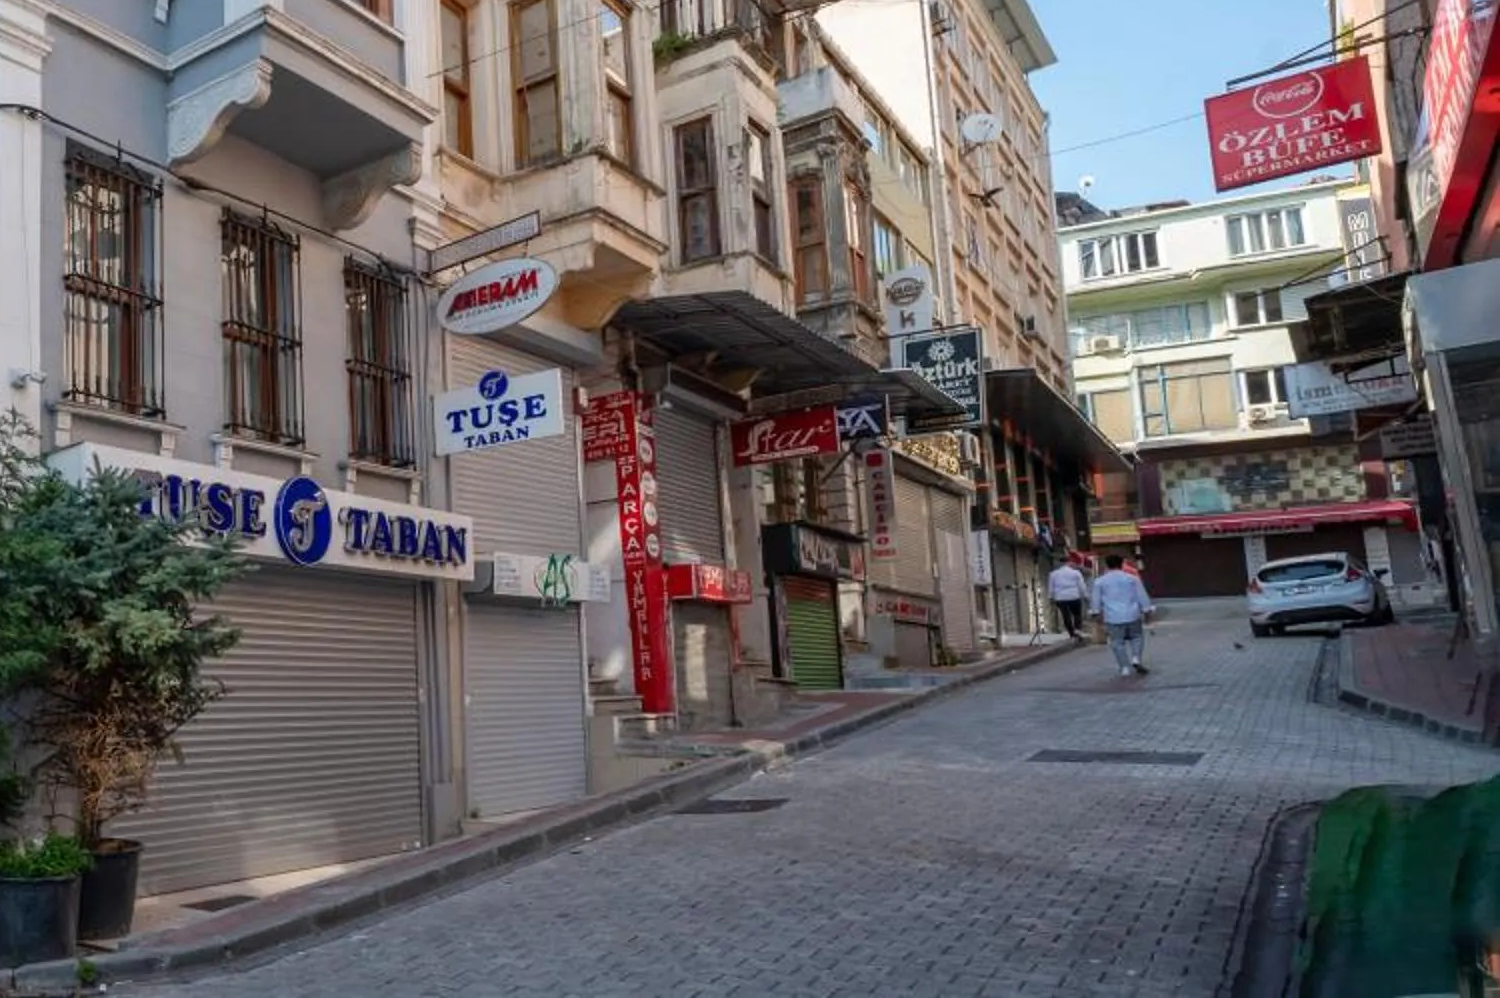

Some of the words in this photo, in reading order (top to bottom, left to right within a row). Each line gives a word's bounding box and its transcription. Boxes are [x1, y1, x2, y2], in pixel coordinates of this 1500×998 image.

[1218, 102, 1366, 153] ÖZLEM
[446, 393, 548, 434] TUŞE
[463, 425, 530, 449] TABAN
[338, 506, 467, 566] TABAN
